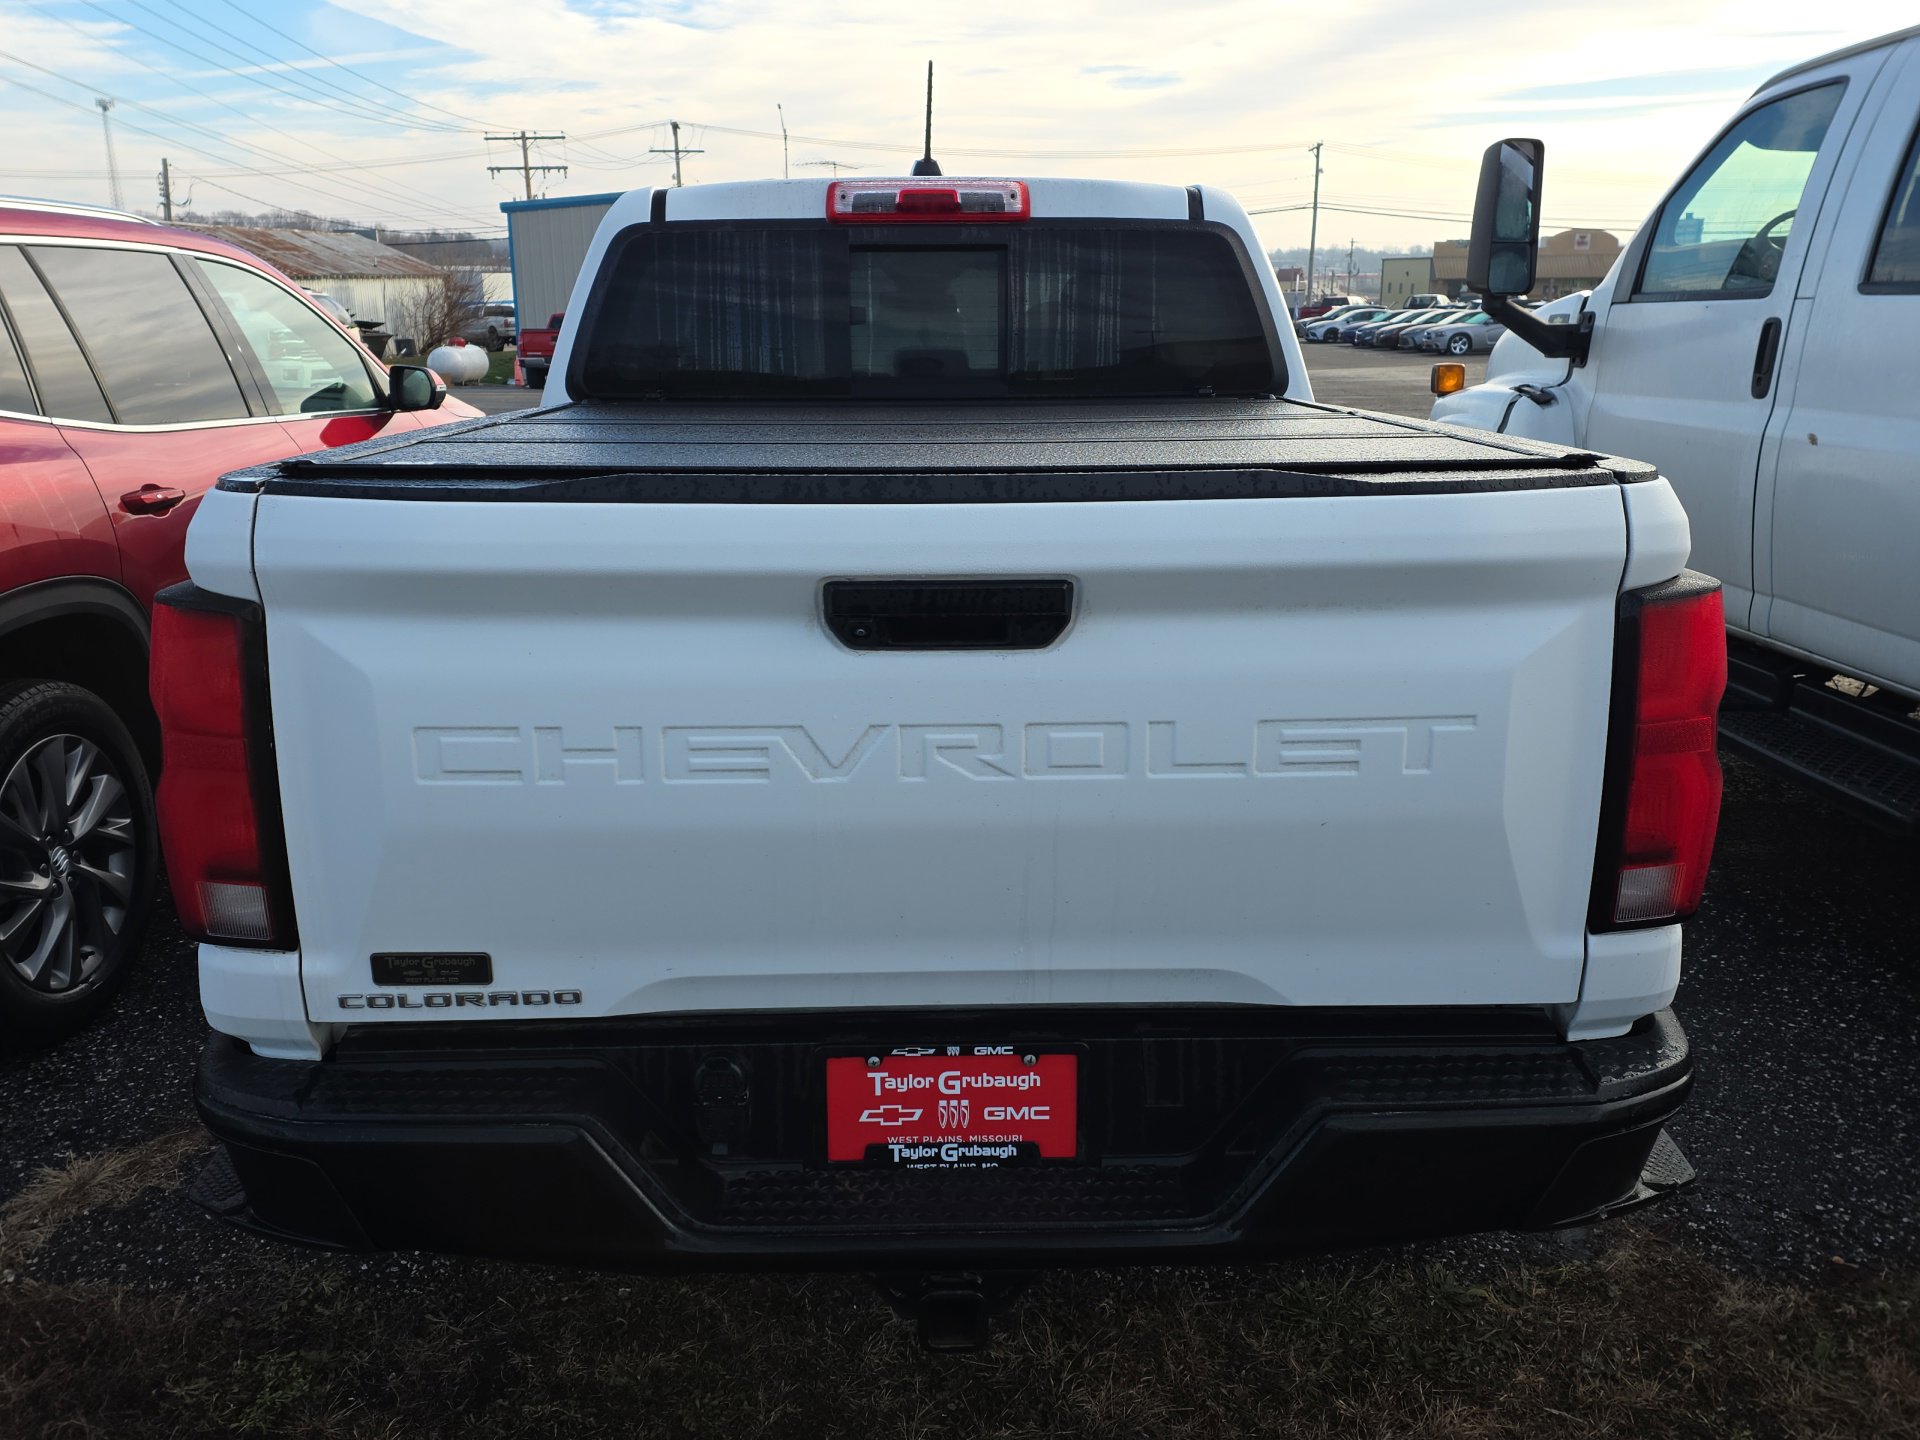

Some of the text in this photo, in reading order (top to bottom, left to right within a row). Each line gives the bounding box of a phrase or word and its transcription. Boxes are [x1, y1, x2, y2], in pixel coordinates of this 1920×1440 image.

[413, 714, 1477, 785] CHEVROLET
[384, 956, 476, 968] Taylor Grubaugh
[337, 989, 582, 1009] COLORADO
[974, 1046, 1014, 1055] GMC
[867, 1071, 1041, 1096] Taylor Grubaugh
[983, 1106, 1050, 1120] GMC
[887, 1136, 919, 1144] WEST
[969, 1134, 1023, 1143] MISSOURI
[889, 1143, 1017, 1162] Taylor Grubaugh
